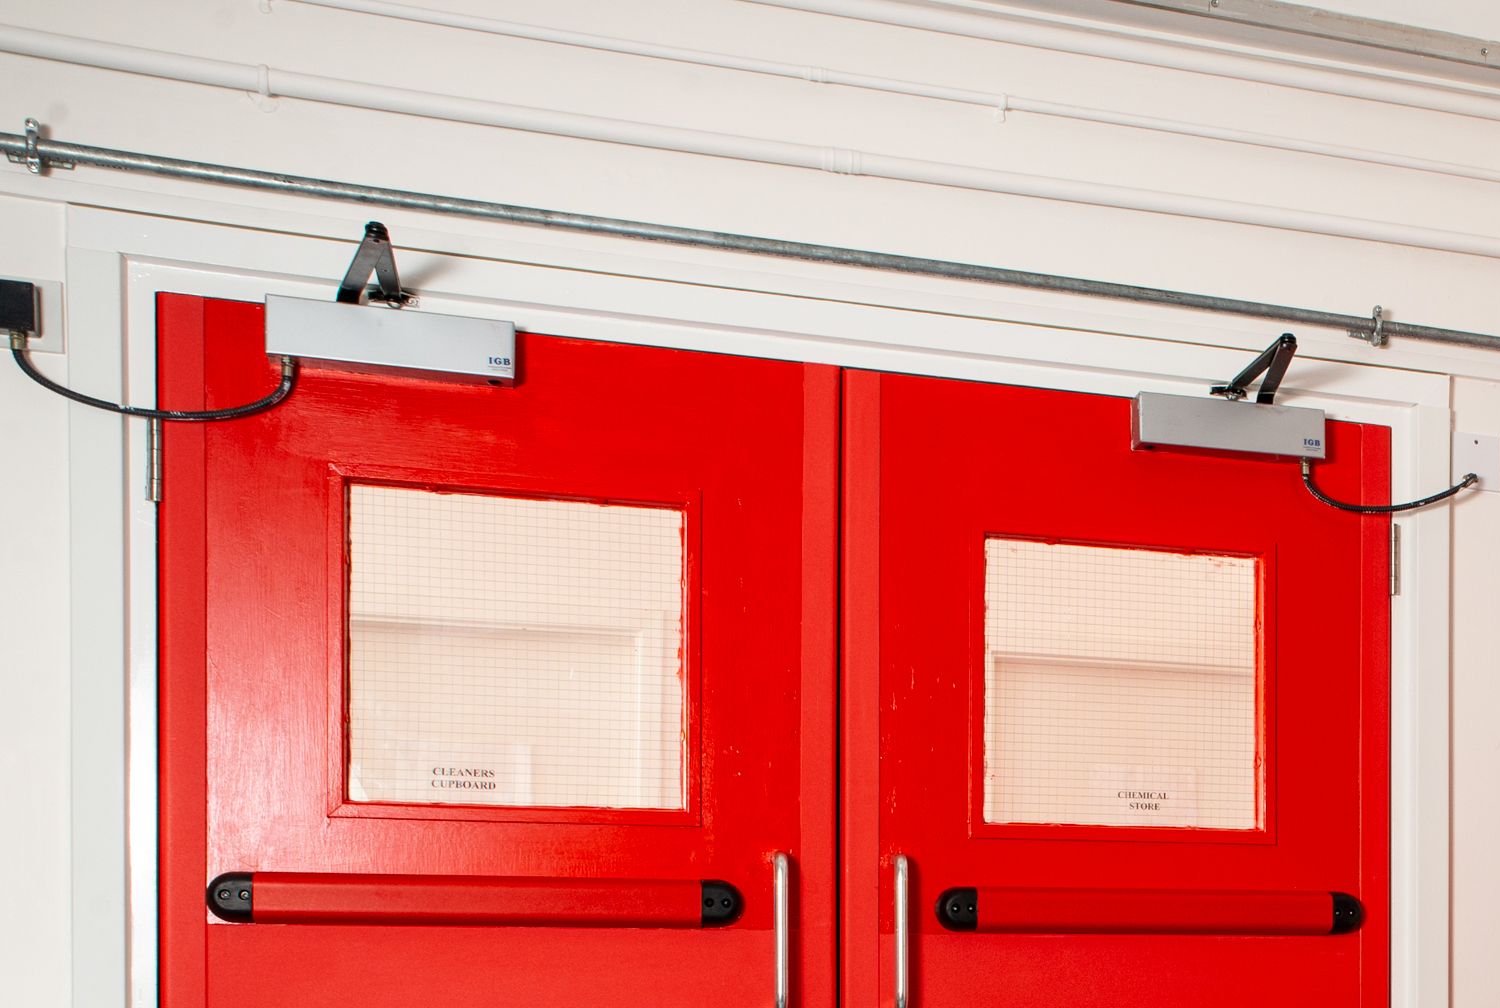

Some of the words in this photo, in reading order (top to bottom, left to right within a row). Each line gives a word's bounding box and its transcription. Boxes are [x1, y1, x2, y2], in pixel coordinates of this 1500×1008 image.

[489, 356, 511, 366] IGB
[1303, 438, 1320, 447] IGB
[432, 767, 495, 778] CLEANERS
[431, 780, 497, 790] CUPBOARD
[1117, 791, 1169, 800] CHEMICAL
[1129, 802, 1161, 811] STORE
